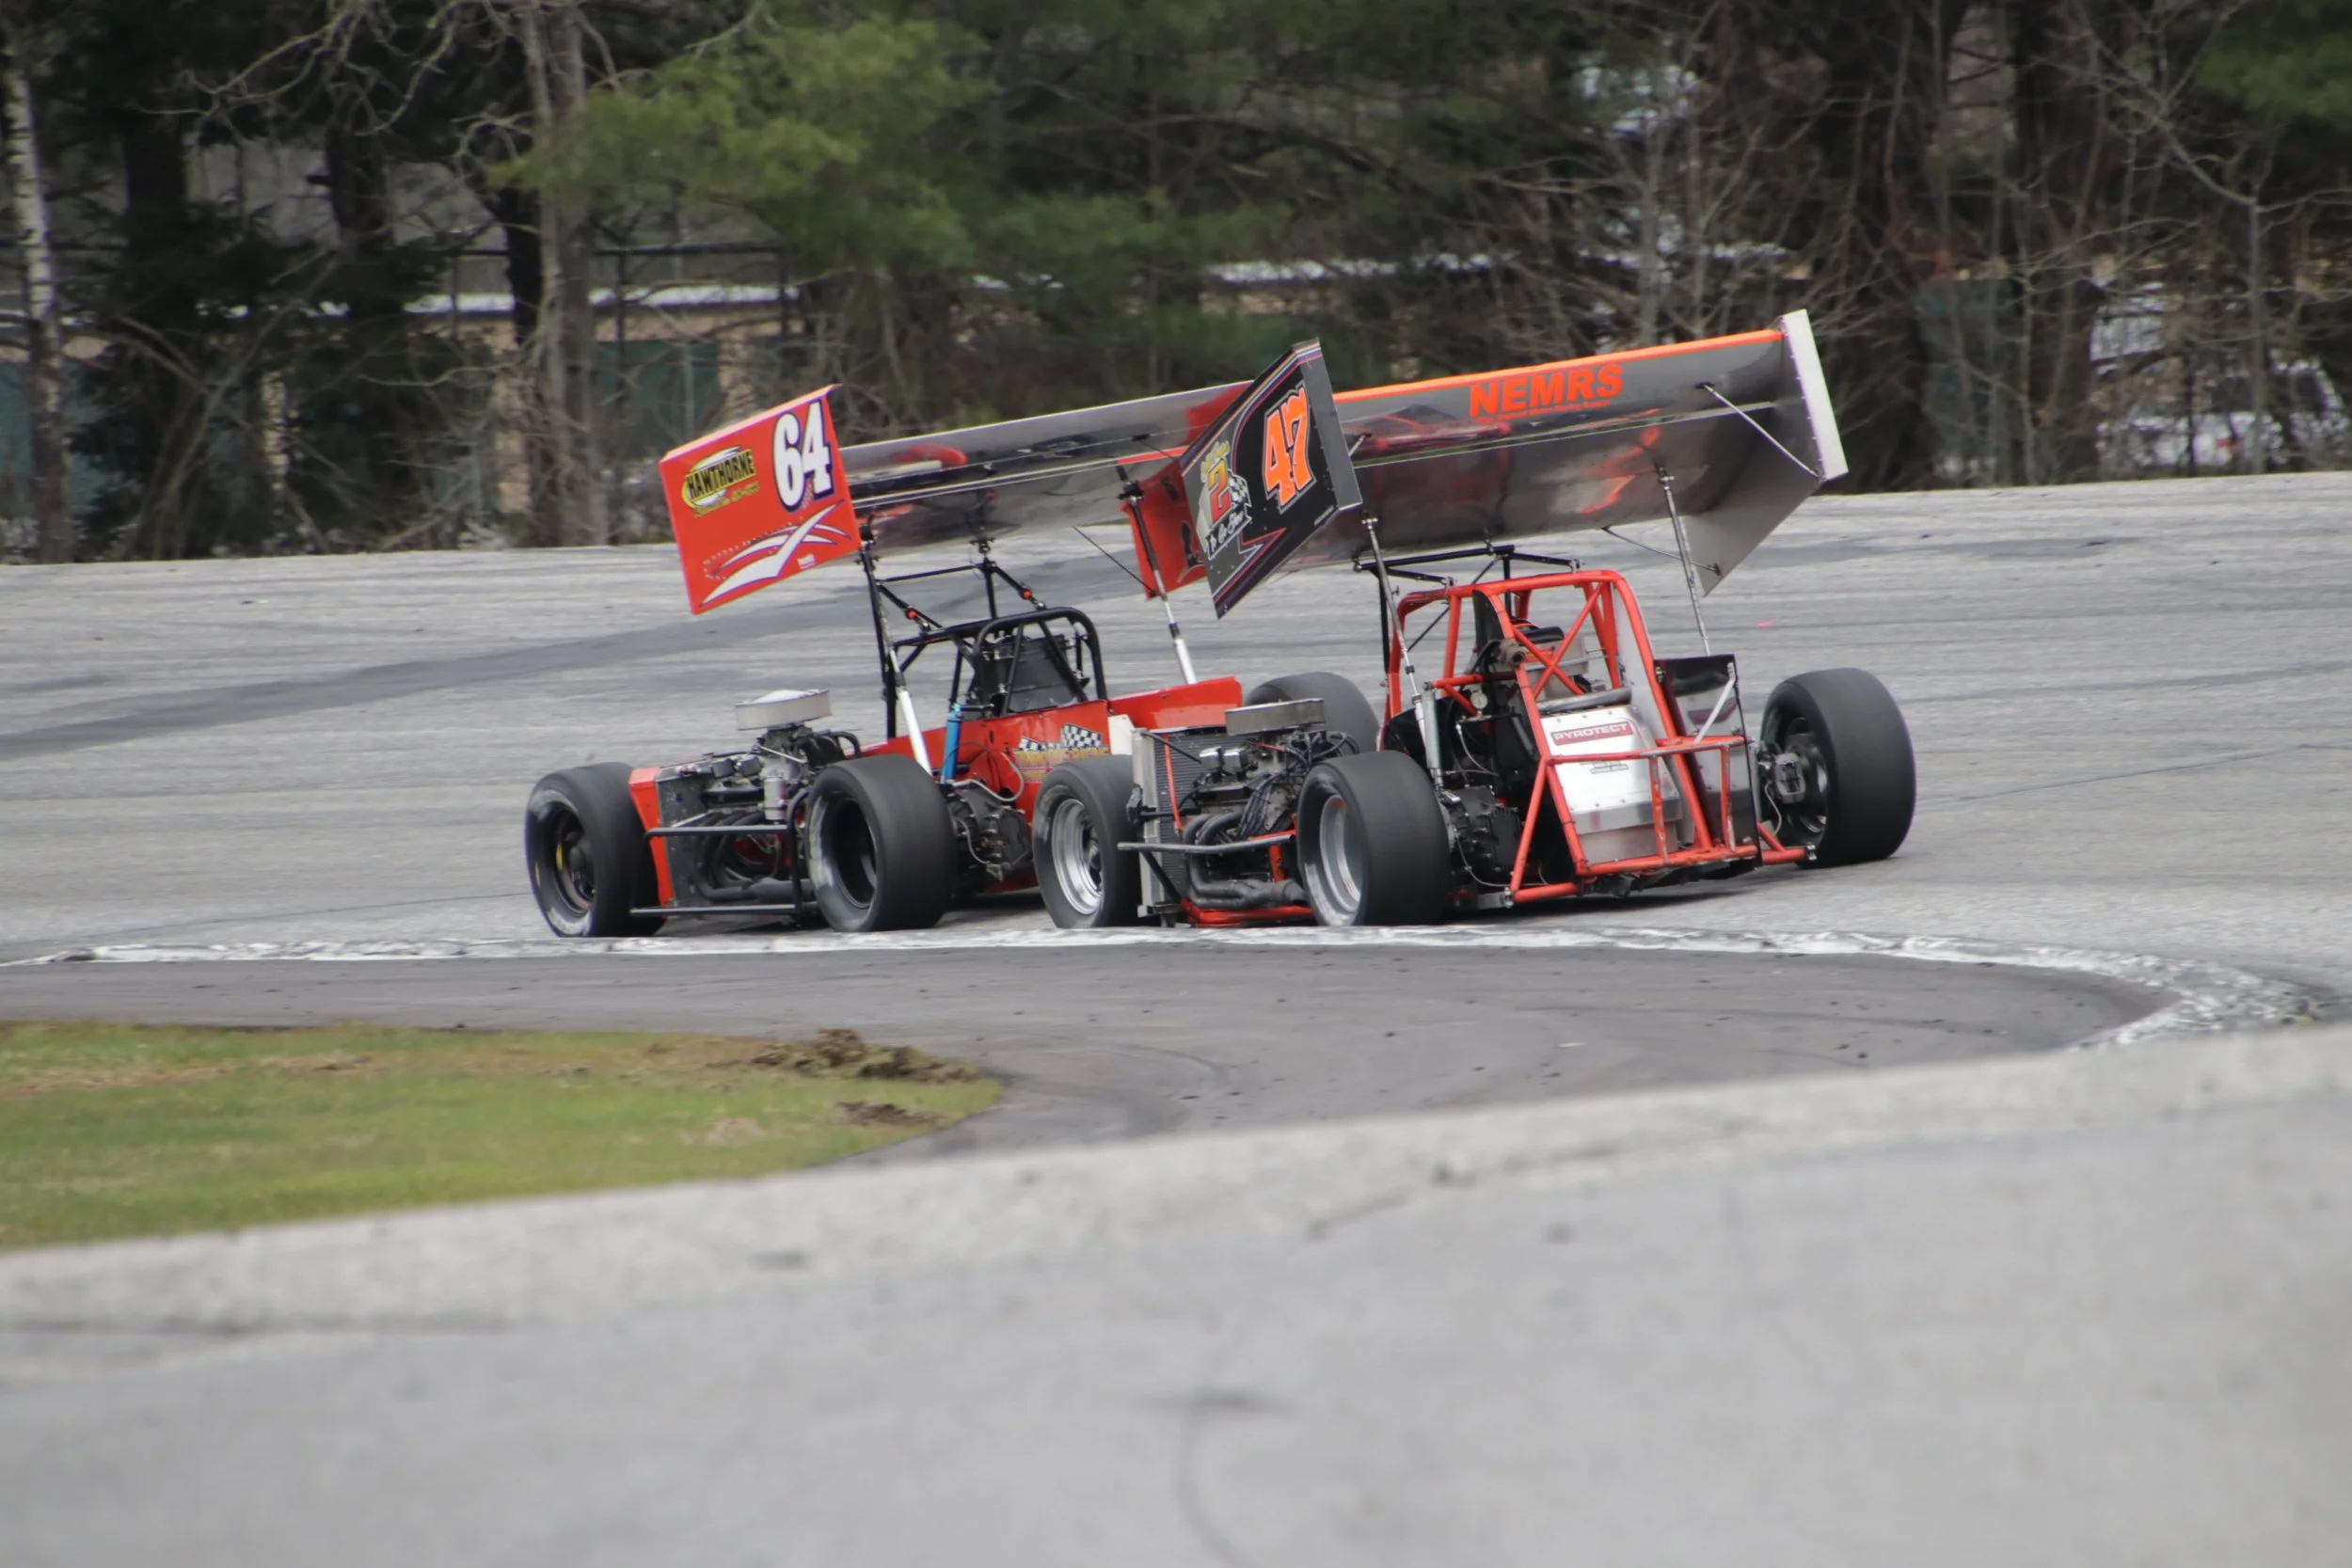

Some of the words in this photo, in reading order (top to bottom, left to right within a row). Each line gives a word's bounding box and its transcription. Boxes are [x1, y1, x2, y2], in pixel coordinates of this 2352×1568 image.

[1470, 364, 1623, 417] NEMRS
[687, 451, 755, 500] HAWTHORNE
[773, 400, 834, 512] 64
[1264, 383, 1315, 511] 47
[1207, 459, 1232, 524] 2
[1553, 723, 1628, 740] PYROTECT
